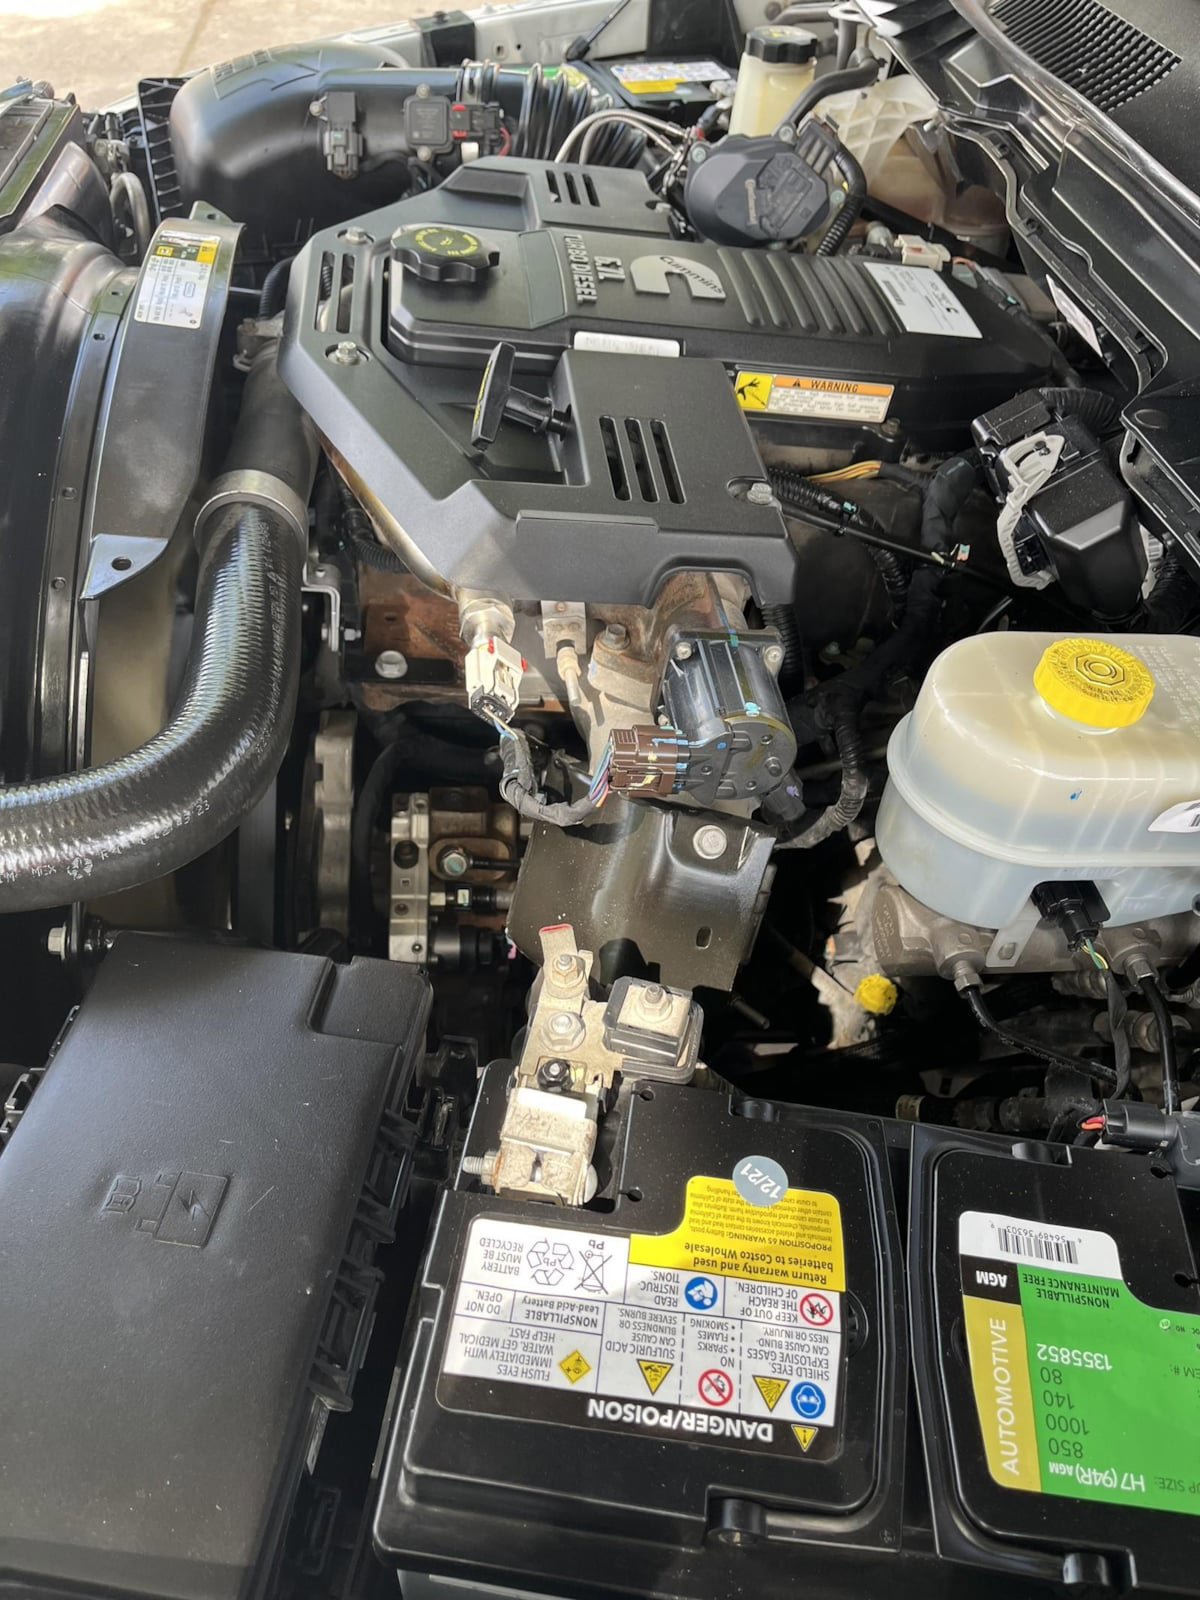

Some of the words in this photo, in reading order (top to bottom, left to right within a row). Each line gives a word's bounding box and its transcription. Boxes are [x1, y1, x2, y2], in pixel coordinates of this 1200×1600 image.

[564, 233, 589, 262] TURBO
[660, 256, 722, 294] Cummins
[571, 262, 598, 303] DIESEL
[810, 380, 859, 393] WARNING
[740, 1162, 782, 1199] 12/21
[726, 1231, 766, 1244] WARNING:
[1038, 1232, 1066, 1243] 56489
[479, 1236, 524, 1253] RECYCLED
[588, 1239, 605, 1250] Pb
[684, 1242, 738, 1260] Wholesale
[780, 1239, 832, 1252] PROPOSITION
[483, 1250, 494, 1260] BE
[496, 1251, 522, 1264] MUST
[740, 1251, 772, 1264] Costco
[775, 1255, 786, 1266] to
[481, 1260, 520, 1276] BATTERY
[542, 1257, 557, 1267] Pb
[693, 1256, 718, 1268] used
[720, 1261, 740, 1272] and
[788, 1256, 834, 1272] batteries
[742, 1262, 789, 1278] warranty
[650, 1270, 680, 1284] TIONS.
[792, 1271, 827, 1285] Return
[975, 1270, 1008, 1288] AGM
[1022, 1273, 1045, 1286] FREE
[638, 1280, 679, 1295] INSTRUC-
[735, 1282, 784, 1296] CHILDREN.
[785, 1288, 798, 1300] OF
[1048, 1277, 1120, 1298] MAINTENANCE
[476, 1289, 503, 1302] OPEN.
[654, 1295, 678, 1308] READ
[748, 1296, 778, 1308] REACH
[1036, 1287, 1110, 1308] NONSPILLABLE
[464, 1300, 484, 1313] NOT
[522, 1295, 554, 1310] Battery
[556, 1300, 599, 1315] Lead-Acid
[782, 1300, 798, 1312] THE
[488, 1304, 500, 1316] DO
[618, 1308, 646, 1320] BURNS.
[740, 1306, 752, 1316] OF
[754, 1309, 773, 1320] OUT
[524, 1308, 598, 1328] NONSPILLABLE
[618, 1320, 630, 1328] OR
[648, 1312, 677, 1326] SEVERE
[775, 1312, 798, 1324] KEEP
[632, 1321, 676, 1335] BLINDNESS
[690, 1318, 728, 1332] SMOKING
[508, 1326, 530, 1338] FAST.
[532, 1330, 556, 1342] HELP
[632, 1332, 658, 1344] CAUSE
[697, 1330, 728, 1342] FLAMES
[762, 1326, 794, 1338] INJURY.
[796, 1331, 807, 1341] OR
[809, 1332, 829, 1344] NESS
[459, 1332, 500, 1346] MEDICAL
[501, 1338, 518, 1349] GET
[659, 1336, 676, 1347] CAN
[756, 1338, 782, 1350] BLIND-
[464, 1346, 488, 1359] WITH
[520, 1341, 554, 1356] WATER.
[605, 1340, 628, 1352] ACID
[630, 1344, 676, 1360] SULFURIC
[697, 1341, 728, 1354] SPARKS
[784, 1340, 810, 1353] CAUSE
[812, 1344, 828, 1356] CAN
[489, 1351, 552, 1368] IMMEDIATELY
[746, 1348, 777, 1362] GASES
[778, 1352, 828, 1369] EXPLOSIVE
[1036, 1343, 1112, 1371] 1355852
[720, 1356, 735, 1368] NO
[768, 1362, 793, 1375] EYES.
[496, 1364, 518, 1376] EYES
[520, 1368, 550, 1382] FLUSH
[796, 1367, 830, 1381] SHIELD
[1040, 1366, 1063, 1385] 80
[989, 1317, 1020, 1476] AUTOMOTIVE
[1042, 1389, 1074, 1410] 140
[587, 1398, 773, 1443] DANGER/POISON
[1045, 1413, 1090, 1436] 1000
[1048, 1437, 1084, 1459] 850
[1048, 1461, 1073, 1476] AGM
[1076, 1463, 1118, 1489] (94R)
[1120, 1472, 1146, 1493] H7
